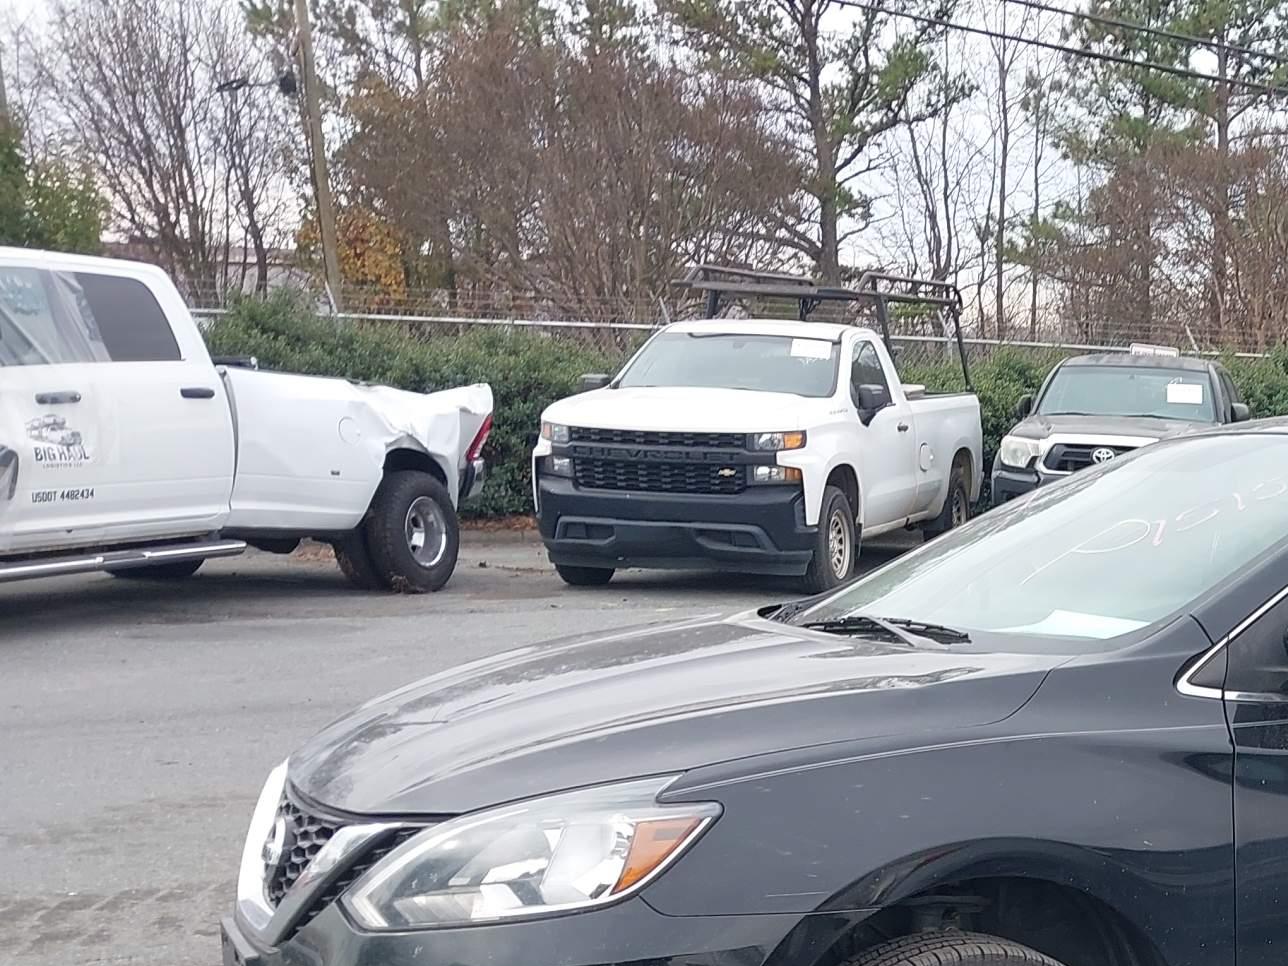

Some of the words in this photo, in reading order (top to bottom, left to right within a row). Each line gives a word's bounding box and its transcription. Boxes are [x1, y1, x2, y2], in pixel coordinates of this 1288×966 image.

[34, 447, 57, 461] BIG
[58, 445, 89, 461] HAUL
[574, 446, 740, 463] CHEVROLET
[31, 490, 57, 503] USDOT
[60, 487, 95, 501] 4482434
